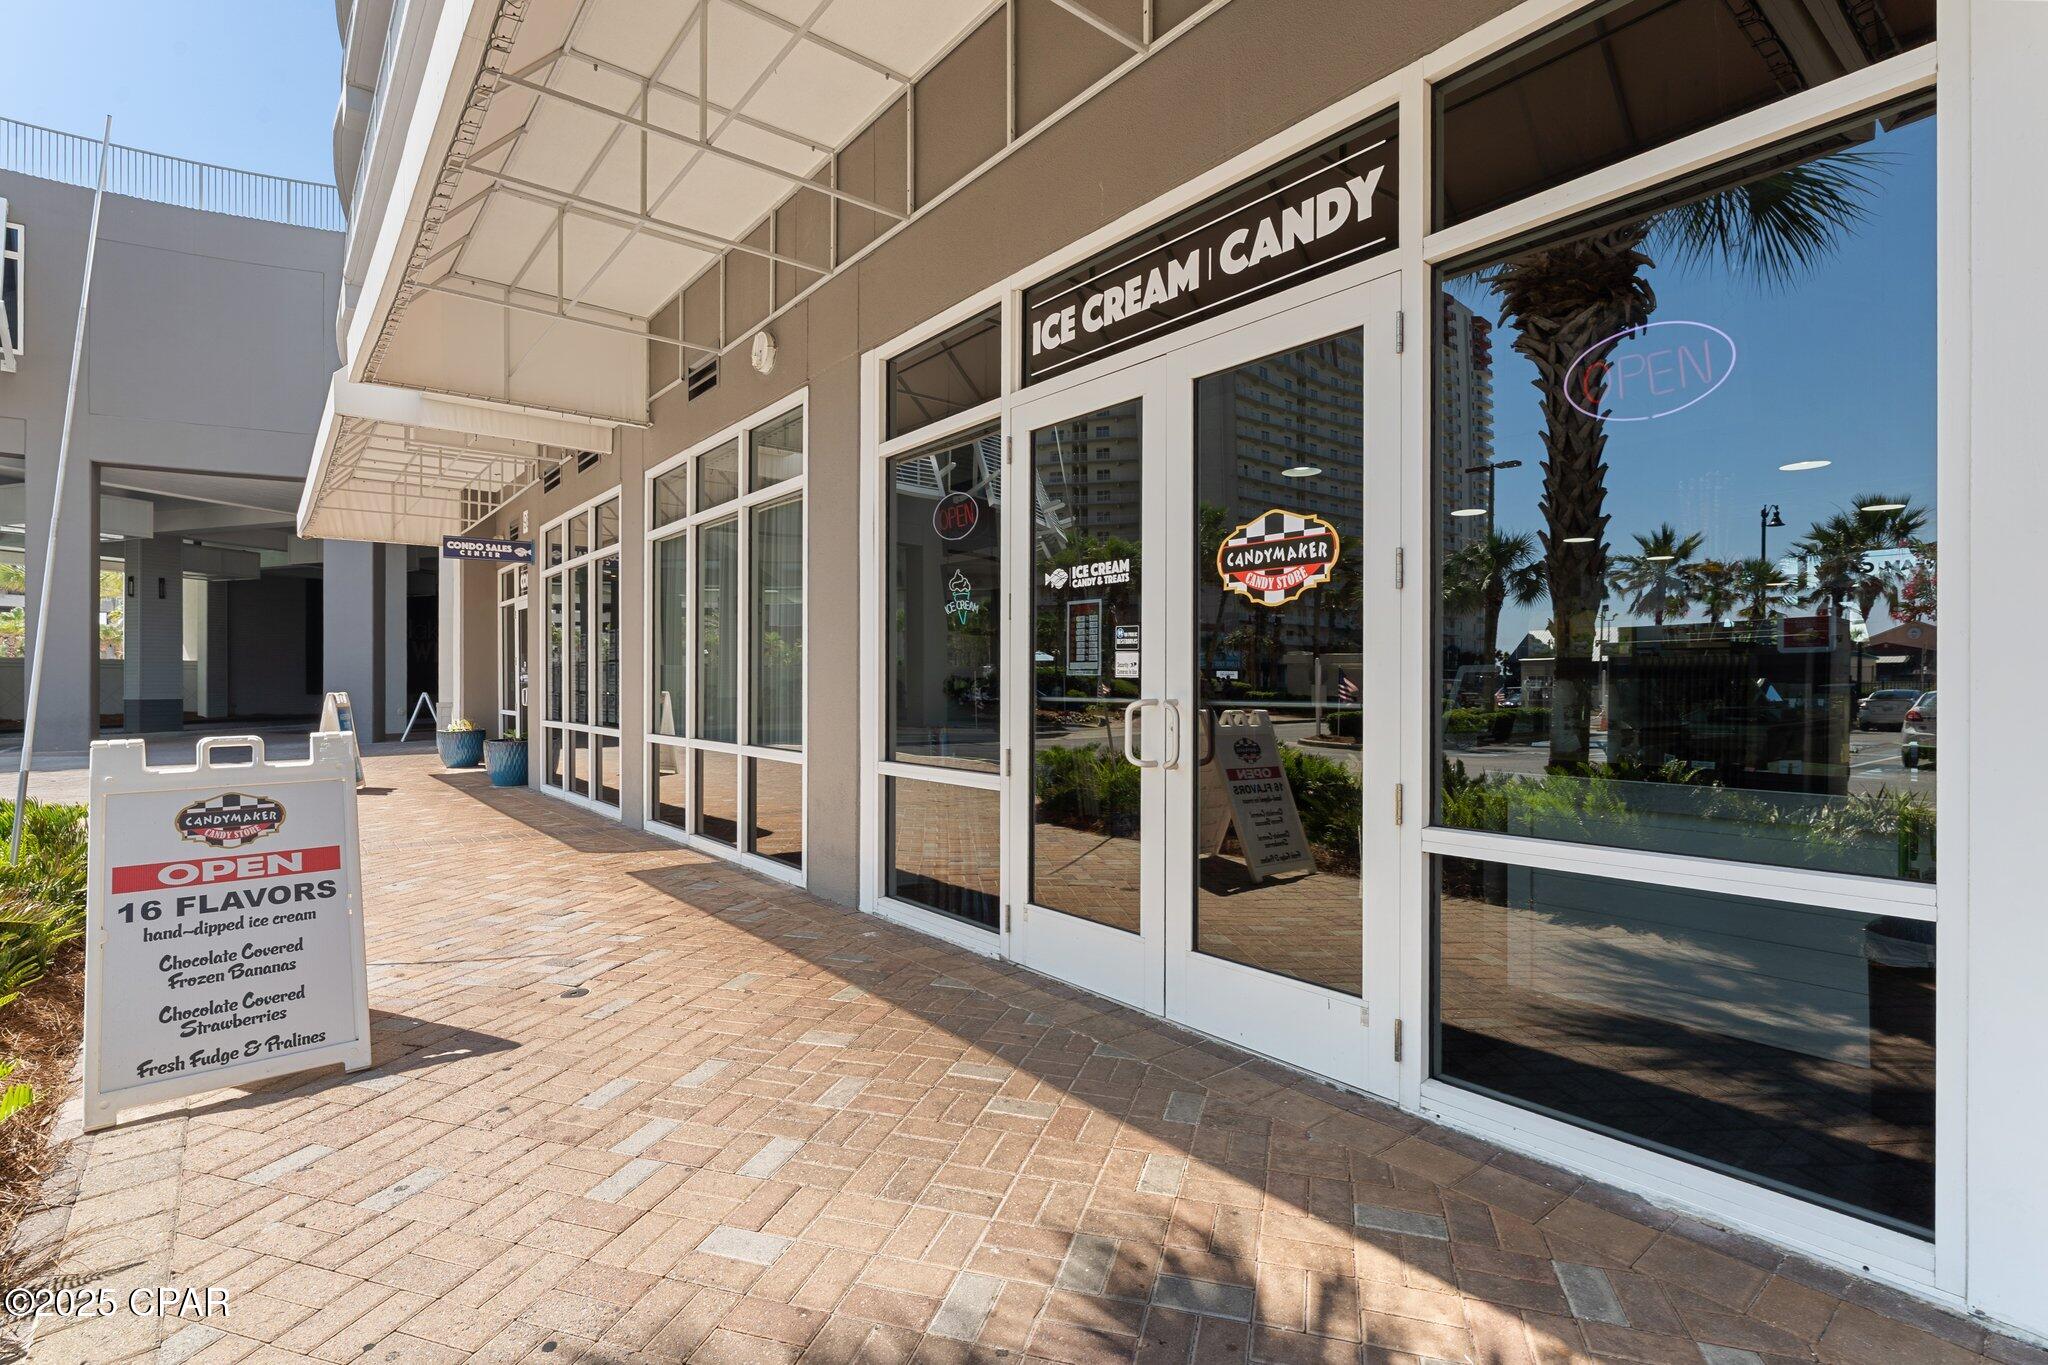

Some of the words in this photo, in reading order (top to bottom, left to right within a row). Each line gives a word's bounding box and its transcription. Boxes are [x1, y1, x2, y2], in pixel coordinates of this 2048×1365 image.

[1032, 304, 1076, 356] ICE
[1081, 248, 1200, 333] CREAM
[1219, 165, 1385, 275] CANDY
[1583, 339, 1713, 404] OPEN
[939, 501, 975, 530] OPEN
[446, 541, 484, 551] CONDO
[485, 543, 513, 553] SALES
[459, 549, 501, 558] CENTER
[1226, 541, 1328, 567] CANDYMAKER
[1072, 565, 1089, 579] ICE
[1090, 558, 1130, 576] CREAM
[1072, 576, 1097, 588] CANDY
[1097, 576, 1104, 586] &
[1104, 572, 1130, 584] TREATS
[1245, 572, 1274, 590] CANDY
[1276, 566, 1308, 589] STORE
[944, 601, 957, 615] ICE
[956, 600, 979, 615] CREAM
[185, 811, 277, 827] CANDYMAKER
[204, 828, 233, 840] CANDY
[234, 824, 262, 838] STORE
[157, 851, 303, 886] OPEN
[117, 899, 163, 924] 16
[176, 879, 338, 917] FLAVORS
[249, 915, 269, 928] ice
[272, 910, 317, 925] cream
[159, 949, 238, 972] Chocolate
[241, 937, 304, 960] Covered
[168, 971, 225, 989] Frozen
[228, 960, 297, 980] Bananas
[158, 999, 239, 1024] Chocolate
[242, 984, 306, 1009] Covered
[180, 1009, 288, 1038] Strawberries
[136, 1056, 185, 1078] Fresh
[189, 1047, 240, 1068] Fudge
[243, 1040, 262, 1058] &
[265, 1031, 326, 1052] Pralines
